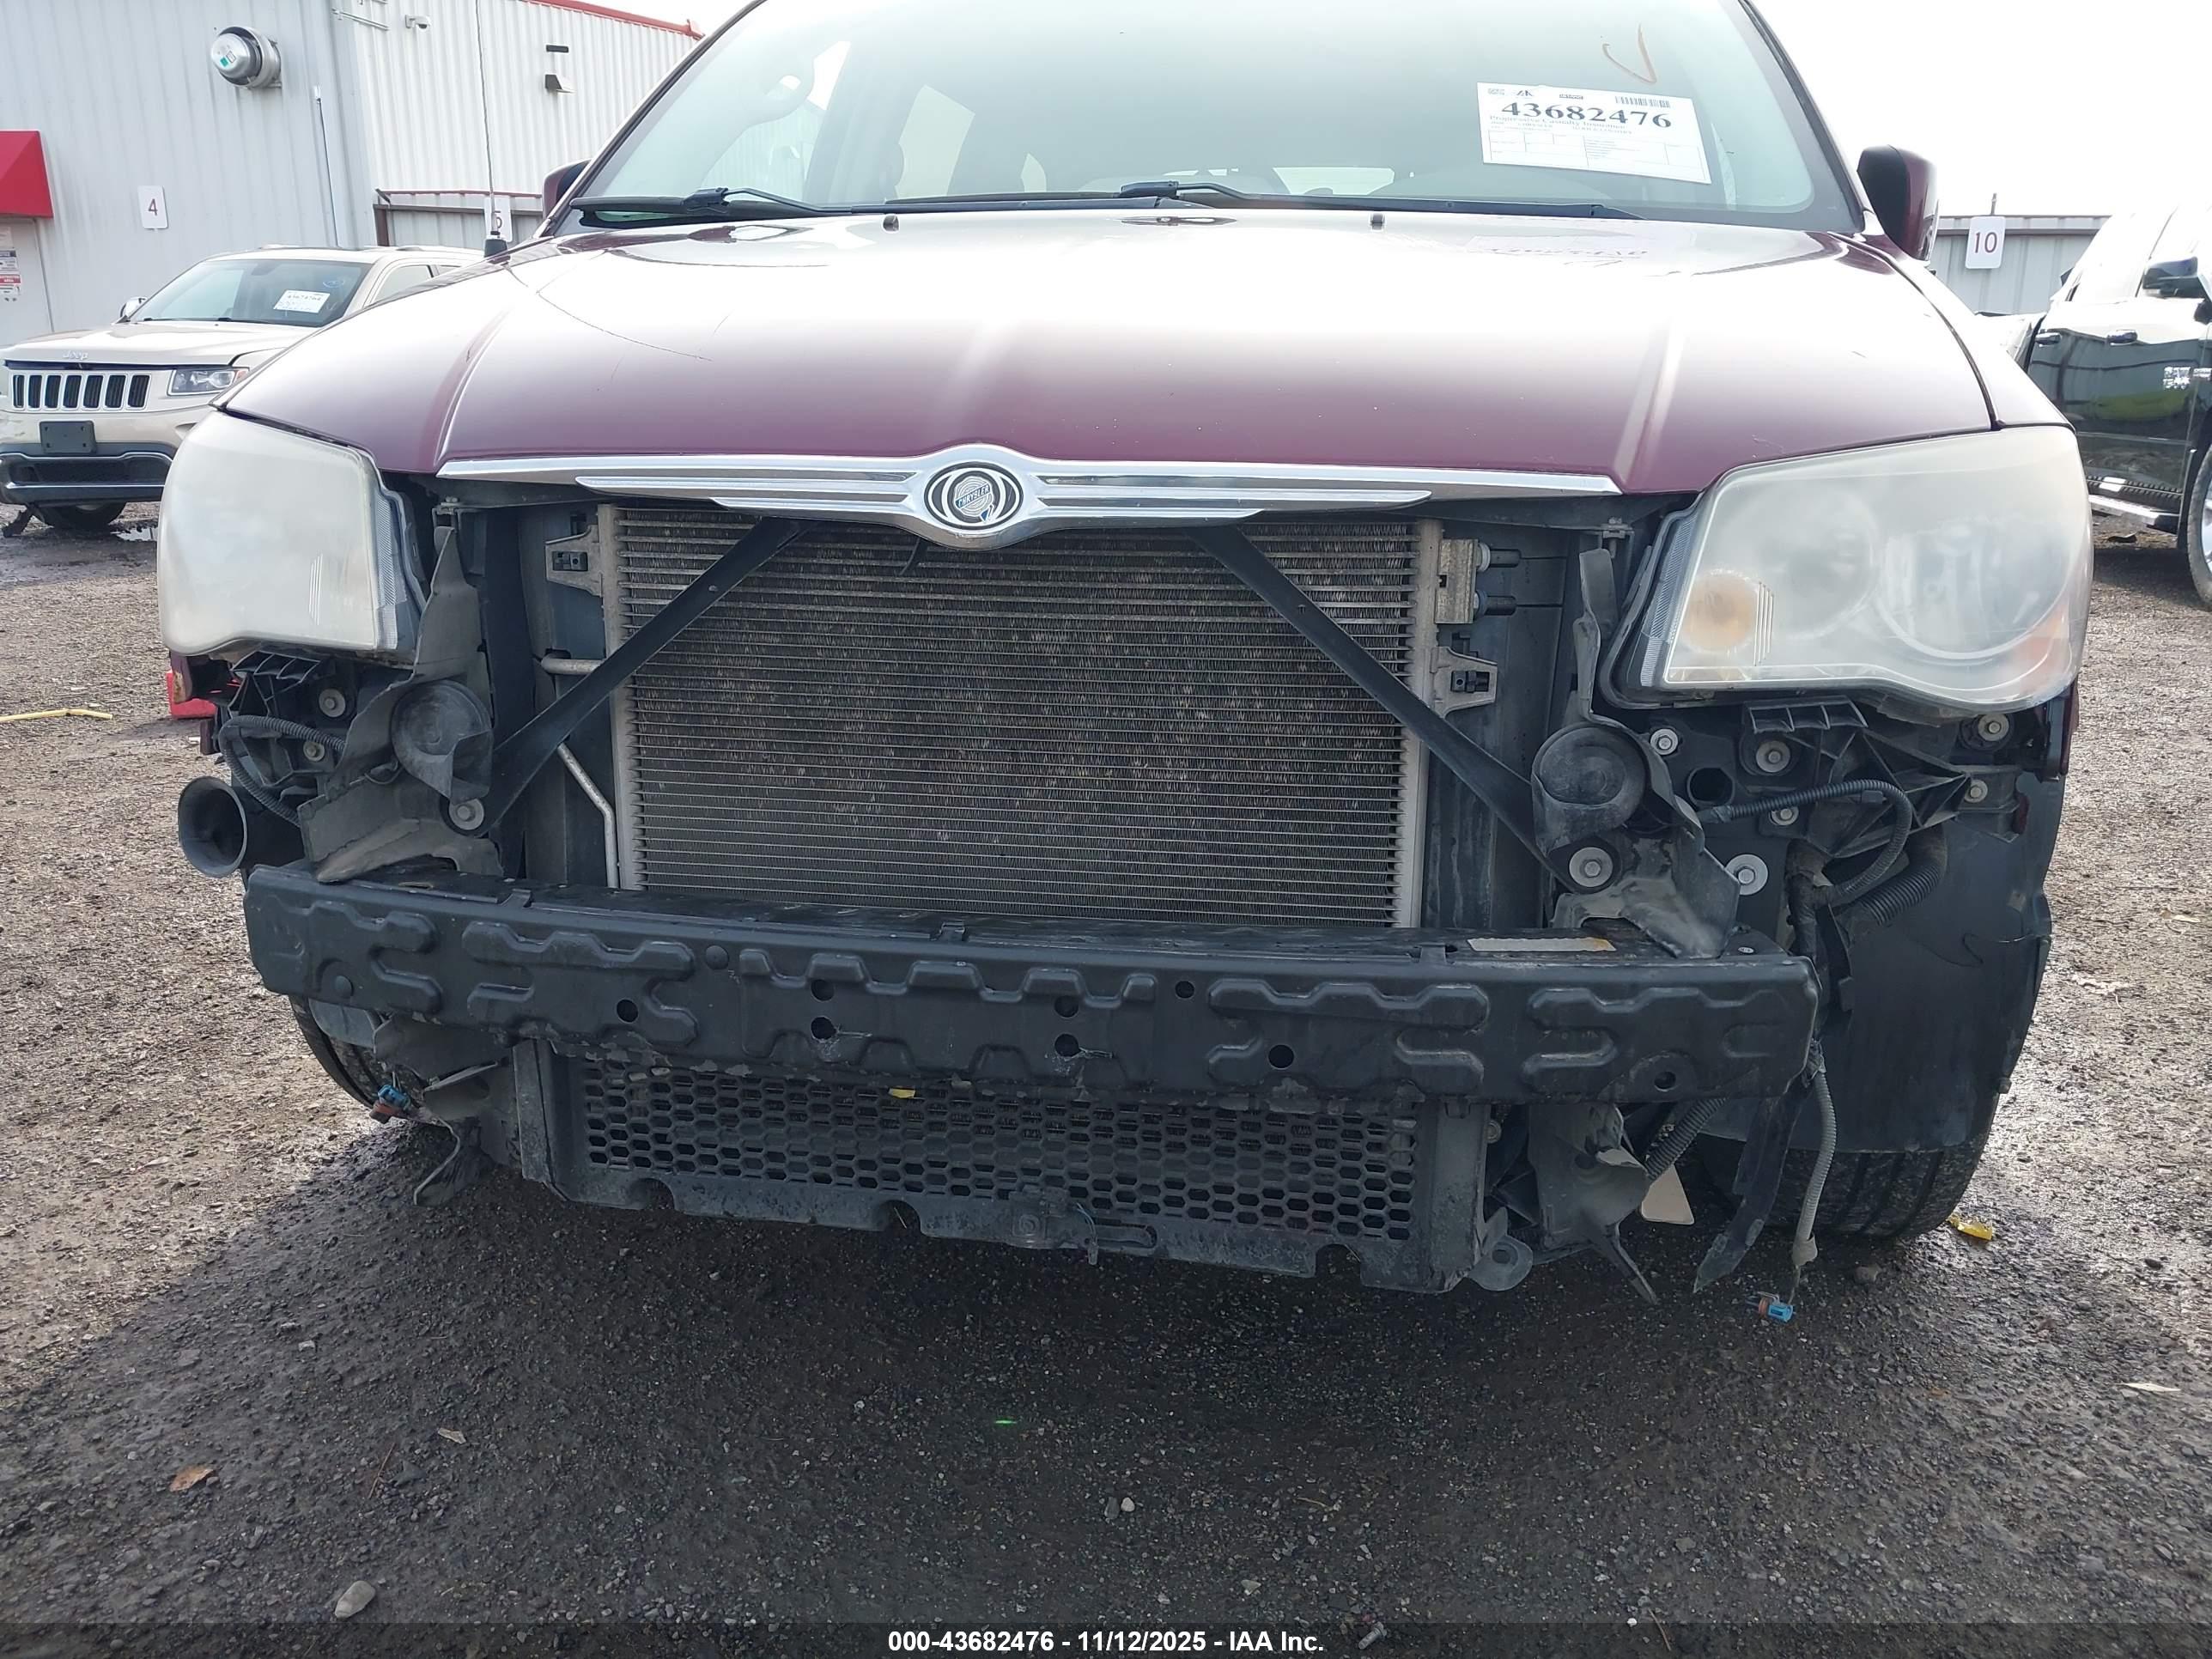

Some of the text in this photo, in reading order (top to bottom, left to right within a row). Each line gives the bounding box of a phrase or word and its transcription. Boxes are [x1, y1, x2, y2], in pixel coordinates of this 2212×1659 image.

[1501, 101, 1672, 129] 43682476
[148, 198, 158, 216] 4
[1975, 232, 1997, 253] 10
[957, 483, 991, 508] CHRYSLER
